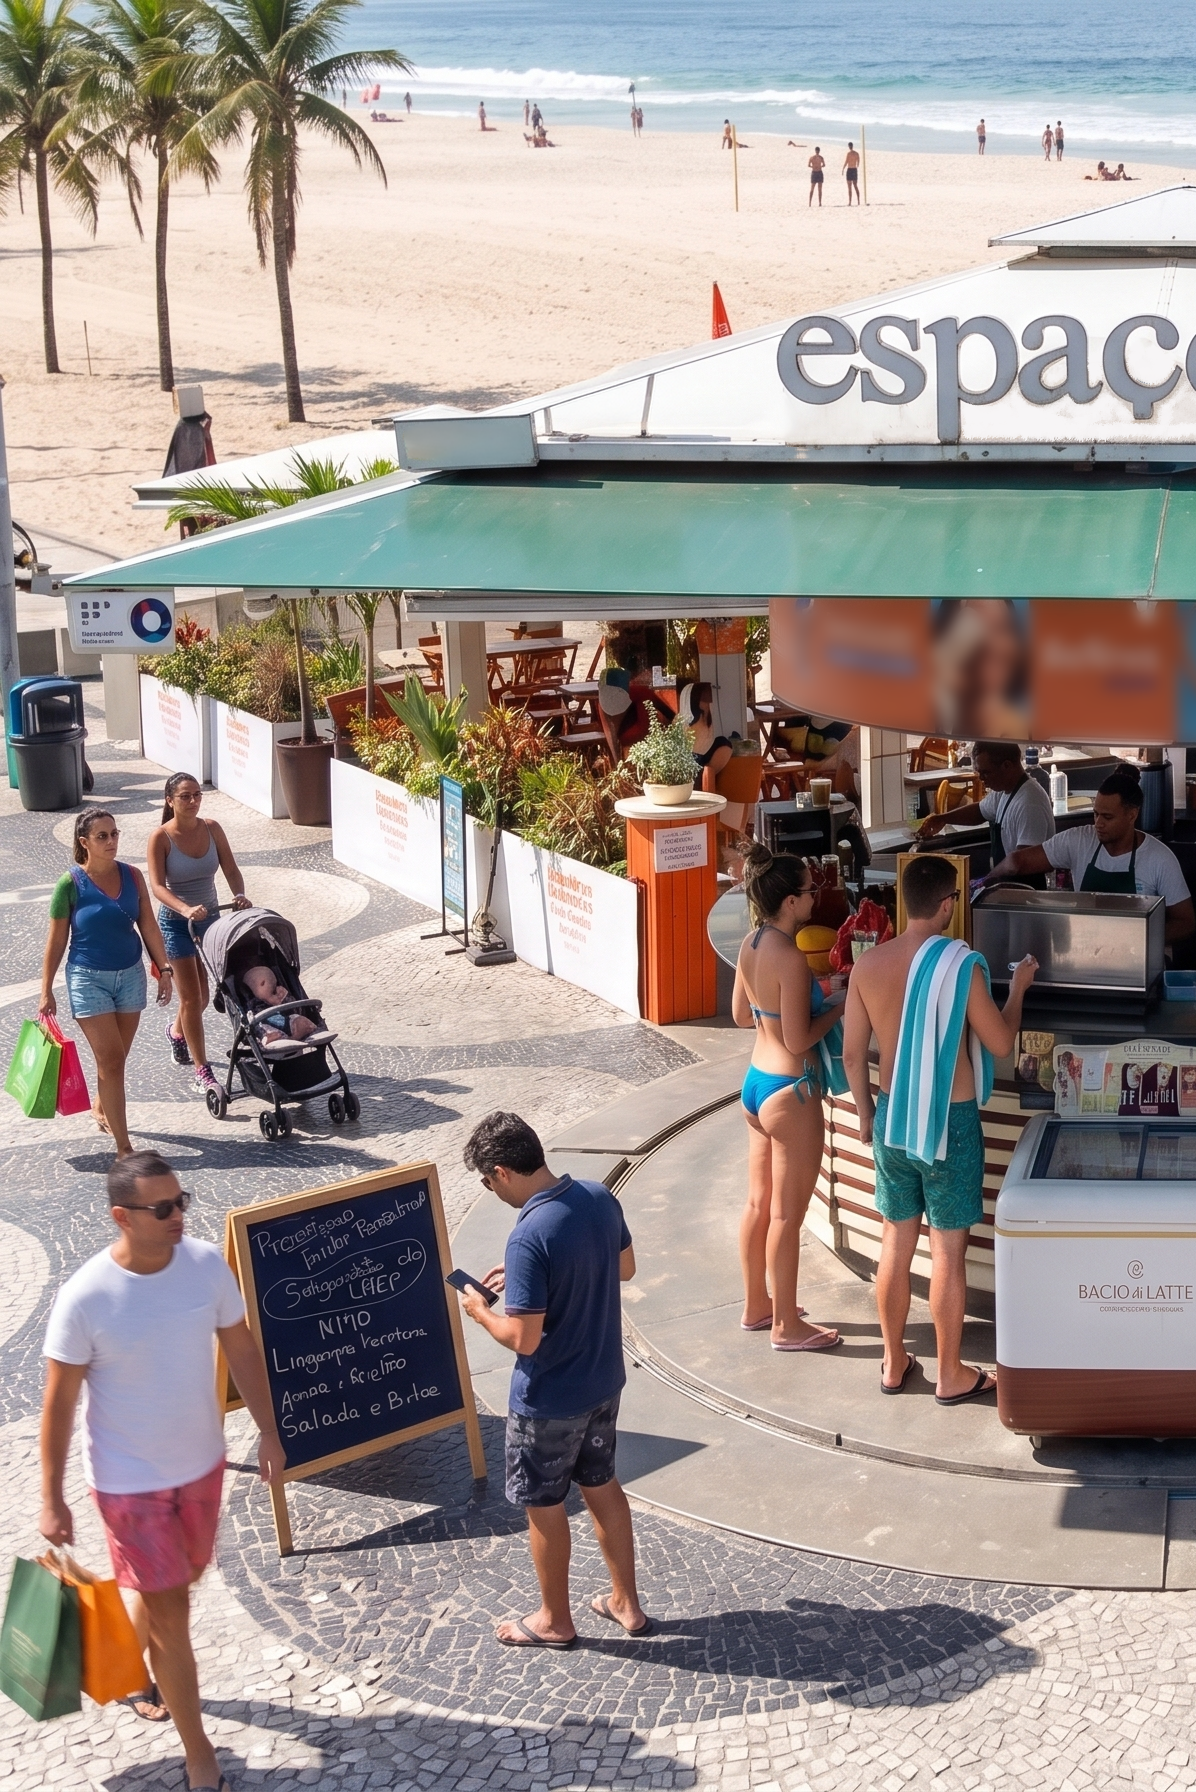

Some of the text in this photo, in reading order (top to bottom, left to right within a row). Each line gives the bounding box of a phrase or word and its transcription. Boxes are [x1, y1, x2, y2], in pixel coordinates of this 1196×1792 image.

[1079, 1284, 1194, 1300] BACIO di LATTE
[281, 1401, 361, 1438] Salada
[370, 1403, 381, 1416] e
